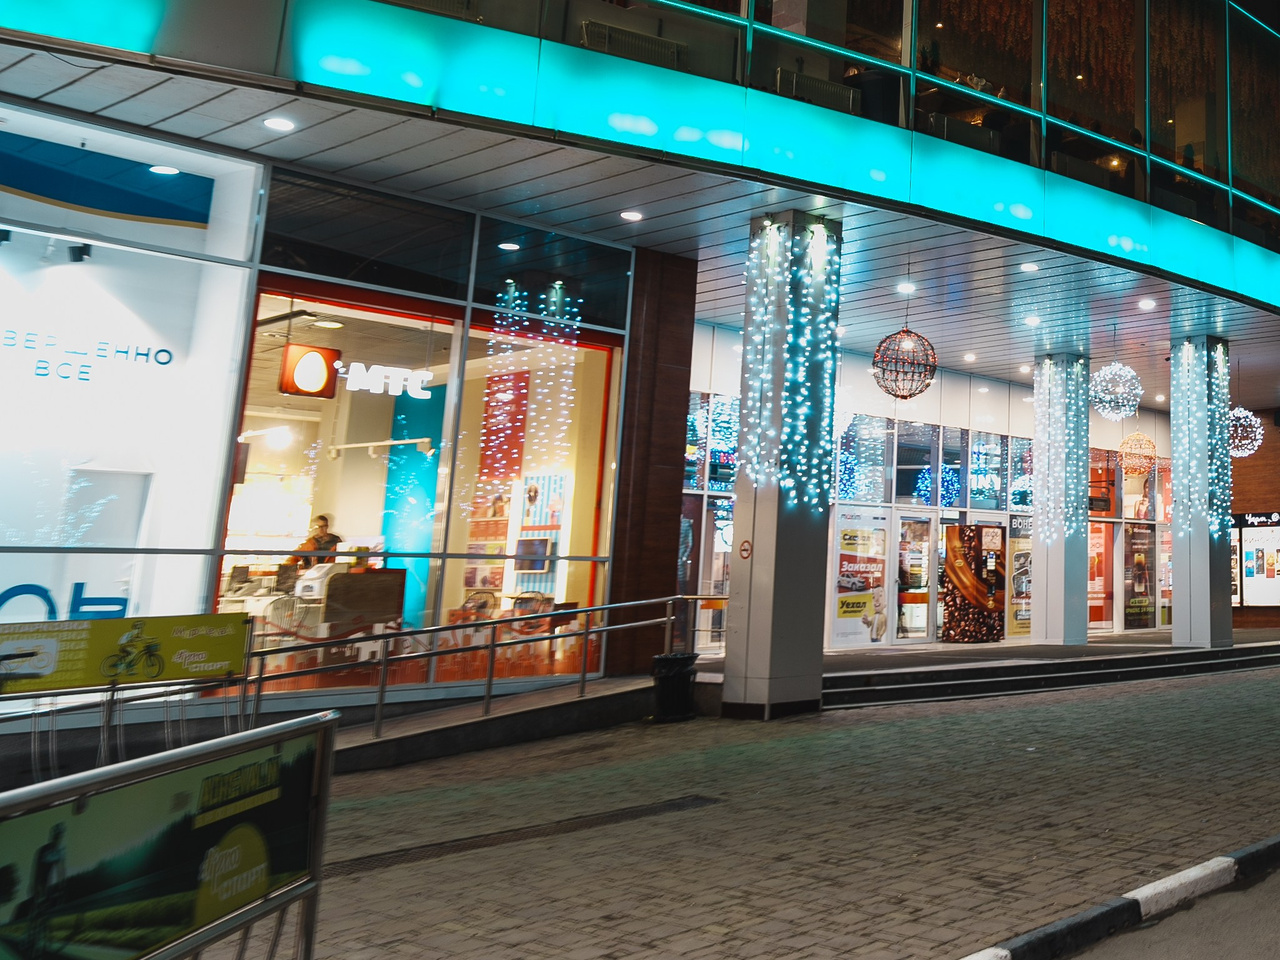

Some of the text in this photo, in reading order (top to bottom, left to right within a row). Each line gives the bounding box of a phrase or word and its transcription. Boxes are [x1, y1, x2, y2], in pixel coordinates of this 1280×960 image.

[34, 360, 92, 381] ВСЕ
[346, 362, 433, 399] МТС
[841, 561, 883, 571] Заказал
[840, 600, 867, 609] Уехал
